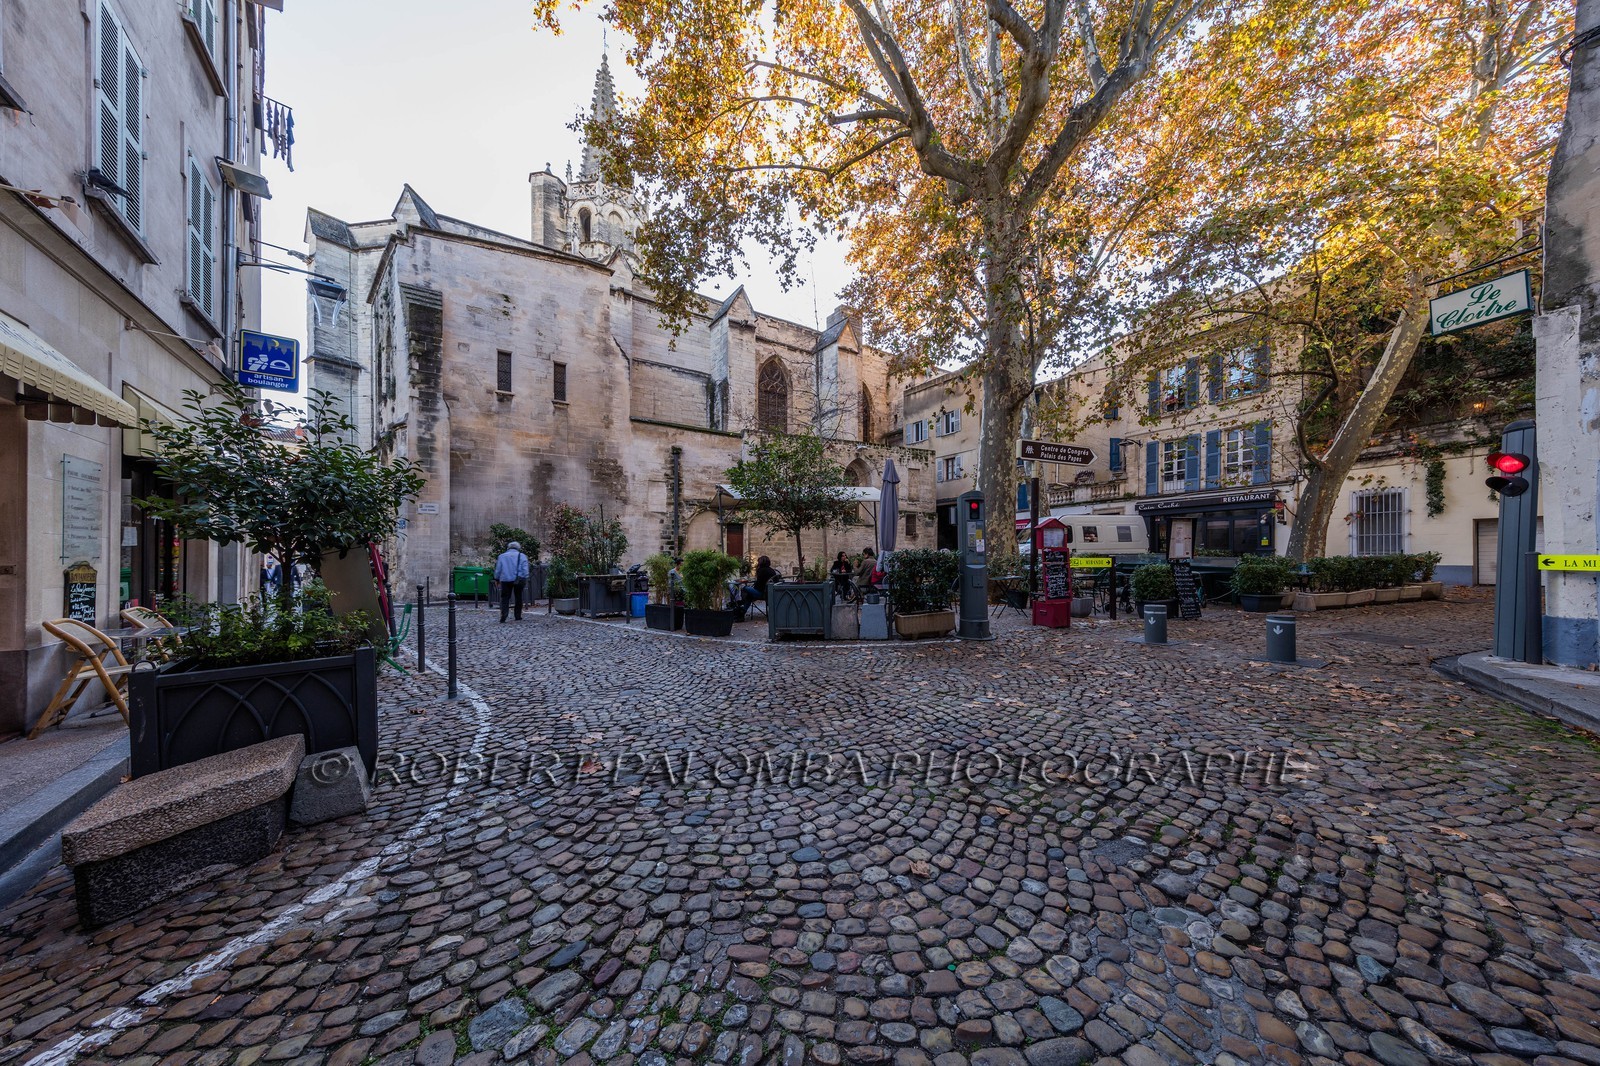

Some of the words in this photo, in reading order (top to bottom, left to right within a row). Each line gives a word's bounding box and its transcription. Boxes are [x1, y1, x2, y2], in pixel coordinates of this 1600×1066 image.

[1467, 283, 1501, 307] Le
[247, 377, 289, 388] boulanger
[253, 373, 284, 382] artisan
[1040, 444, 1059, 453] Centre
[1040, 451, 1056, 460] Palais
[1057, 453, 1067, 461] des
[1067, 454, 1082, 462] Papes
[1222, 493, 1270, 503] RESTAURANT
[1563, 559, 1578, 567] LA
[1583, 559, 1600, 567] MI
